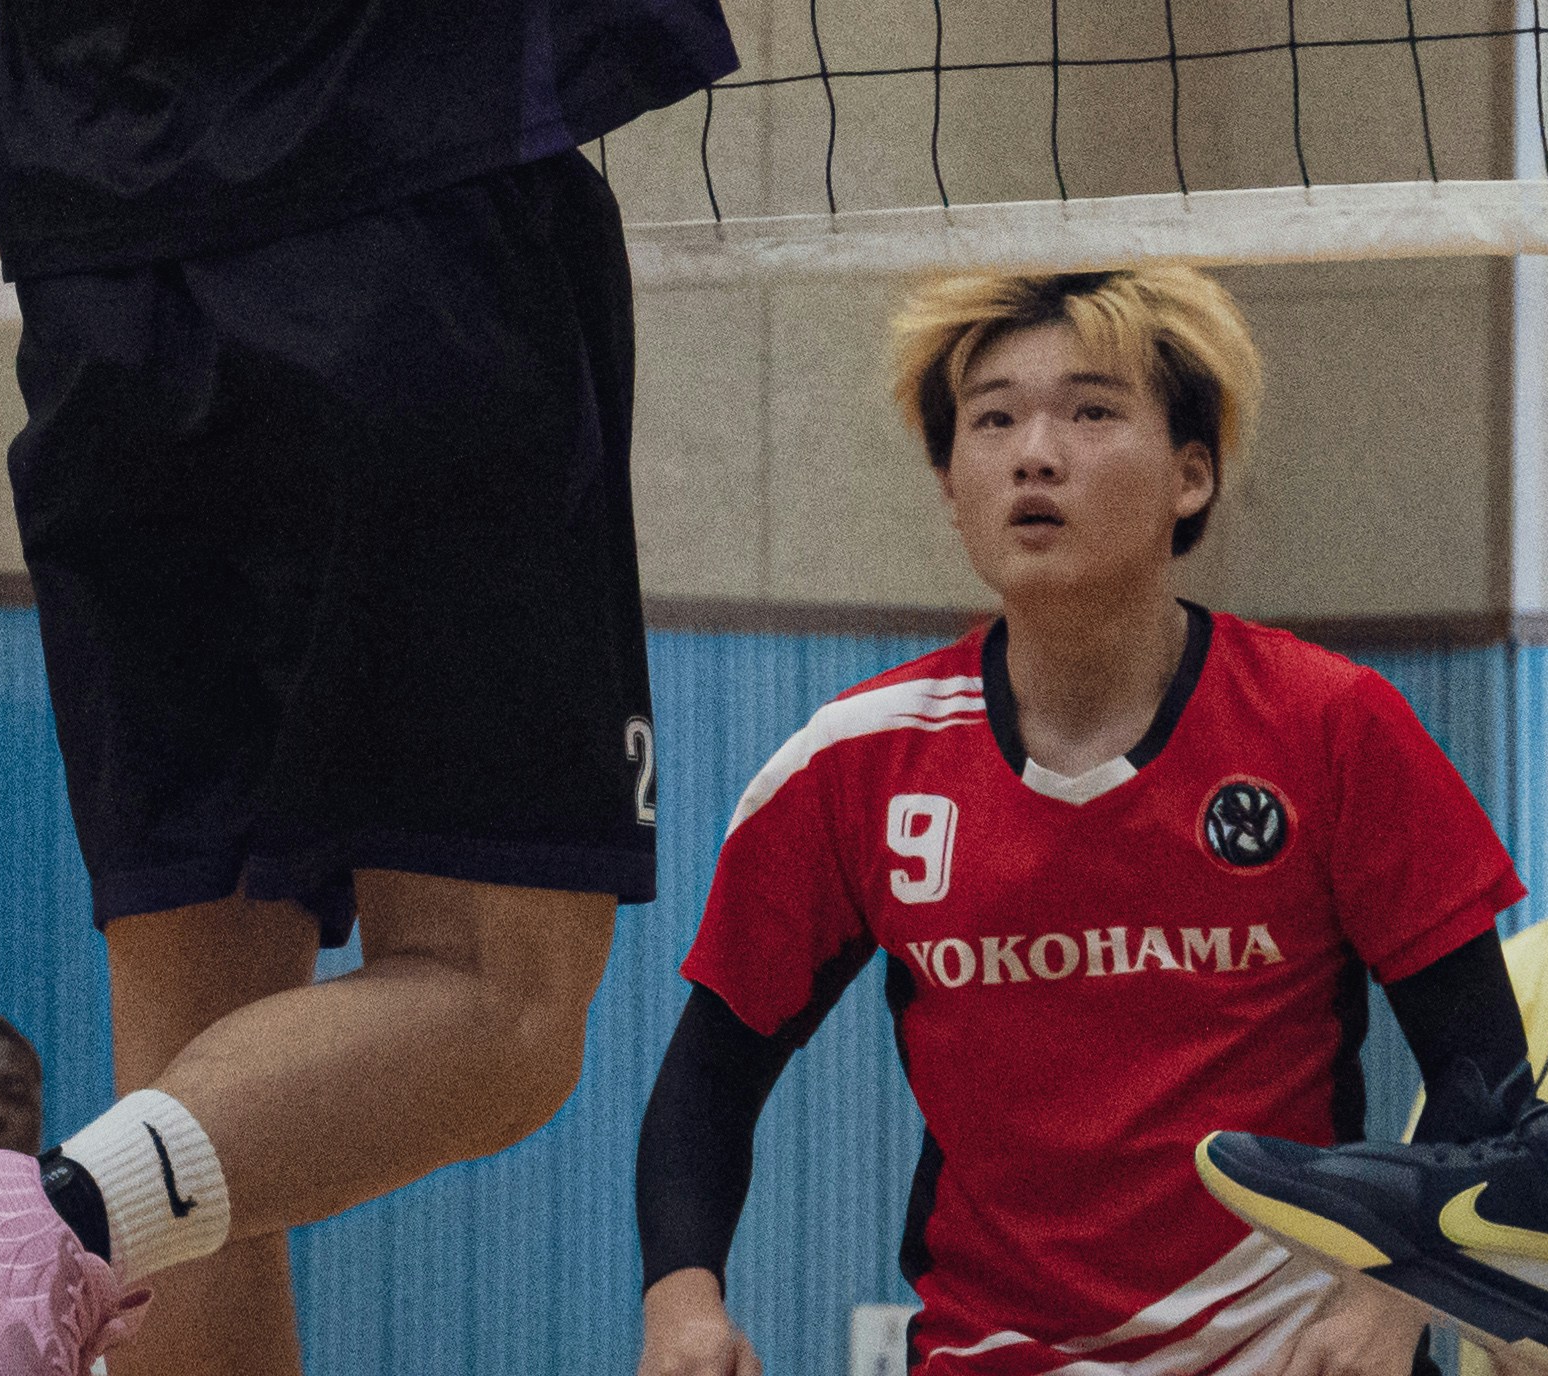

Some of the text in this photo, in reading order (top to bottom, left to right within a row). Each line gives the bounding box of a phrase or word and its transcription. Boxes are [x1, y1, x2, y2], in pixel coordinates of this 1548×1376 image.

[624, 715, 657, 827] 2
[886, 793, 959, 905] 9
[906, 923, 1286, 989] YOKOHAMA
